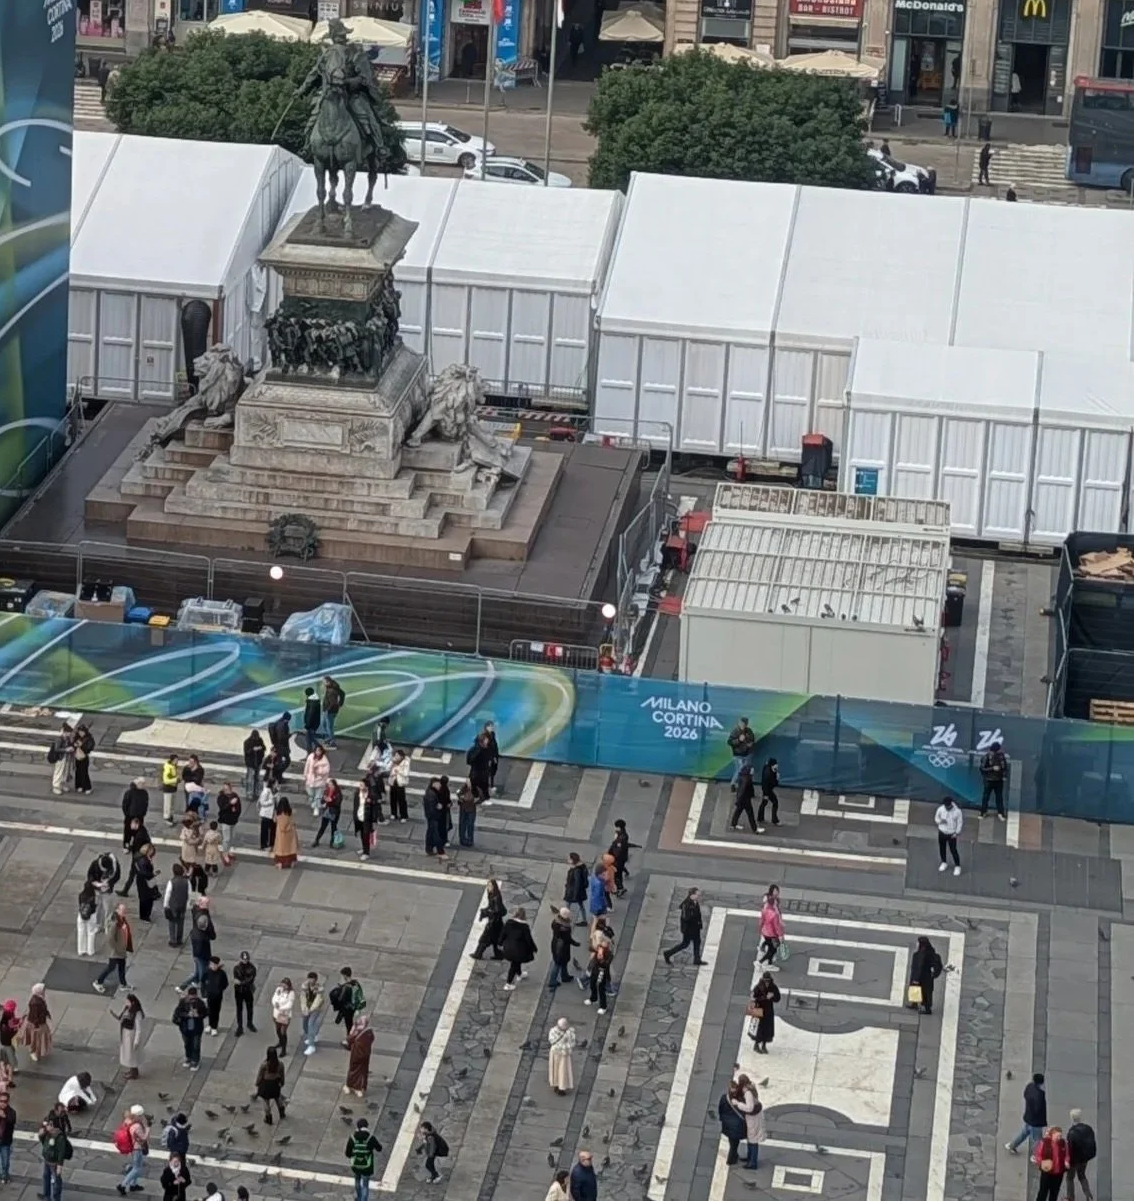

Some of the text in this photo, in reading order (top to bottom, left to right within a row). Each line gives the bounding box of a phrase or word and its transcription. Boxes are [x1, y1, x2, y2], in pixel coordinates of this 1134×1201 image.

[797, 3, 815, 13] BAR
[821, 6, 854, 16] BISTROT
[895, 0, 964, 13] McDonald's
[640, 696, 712, 714] MILANO
[652, 710, 724, 729] CORTINA
[664, 725, 698, 740] 2026
